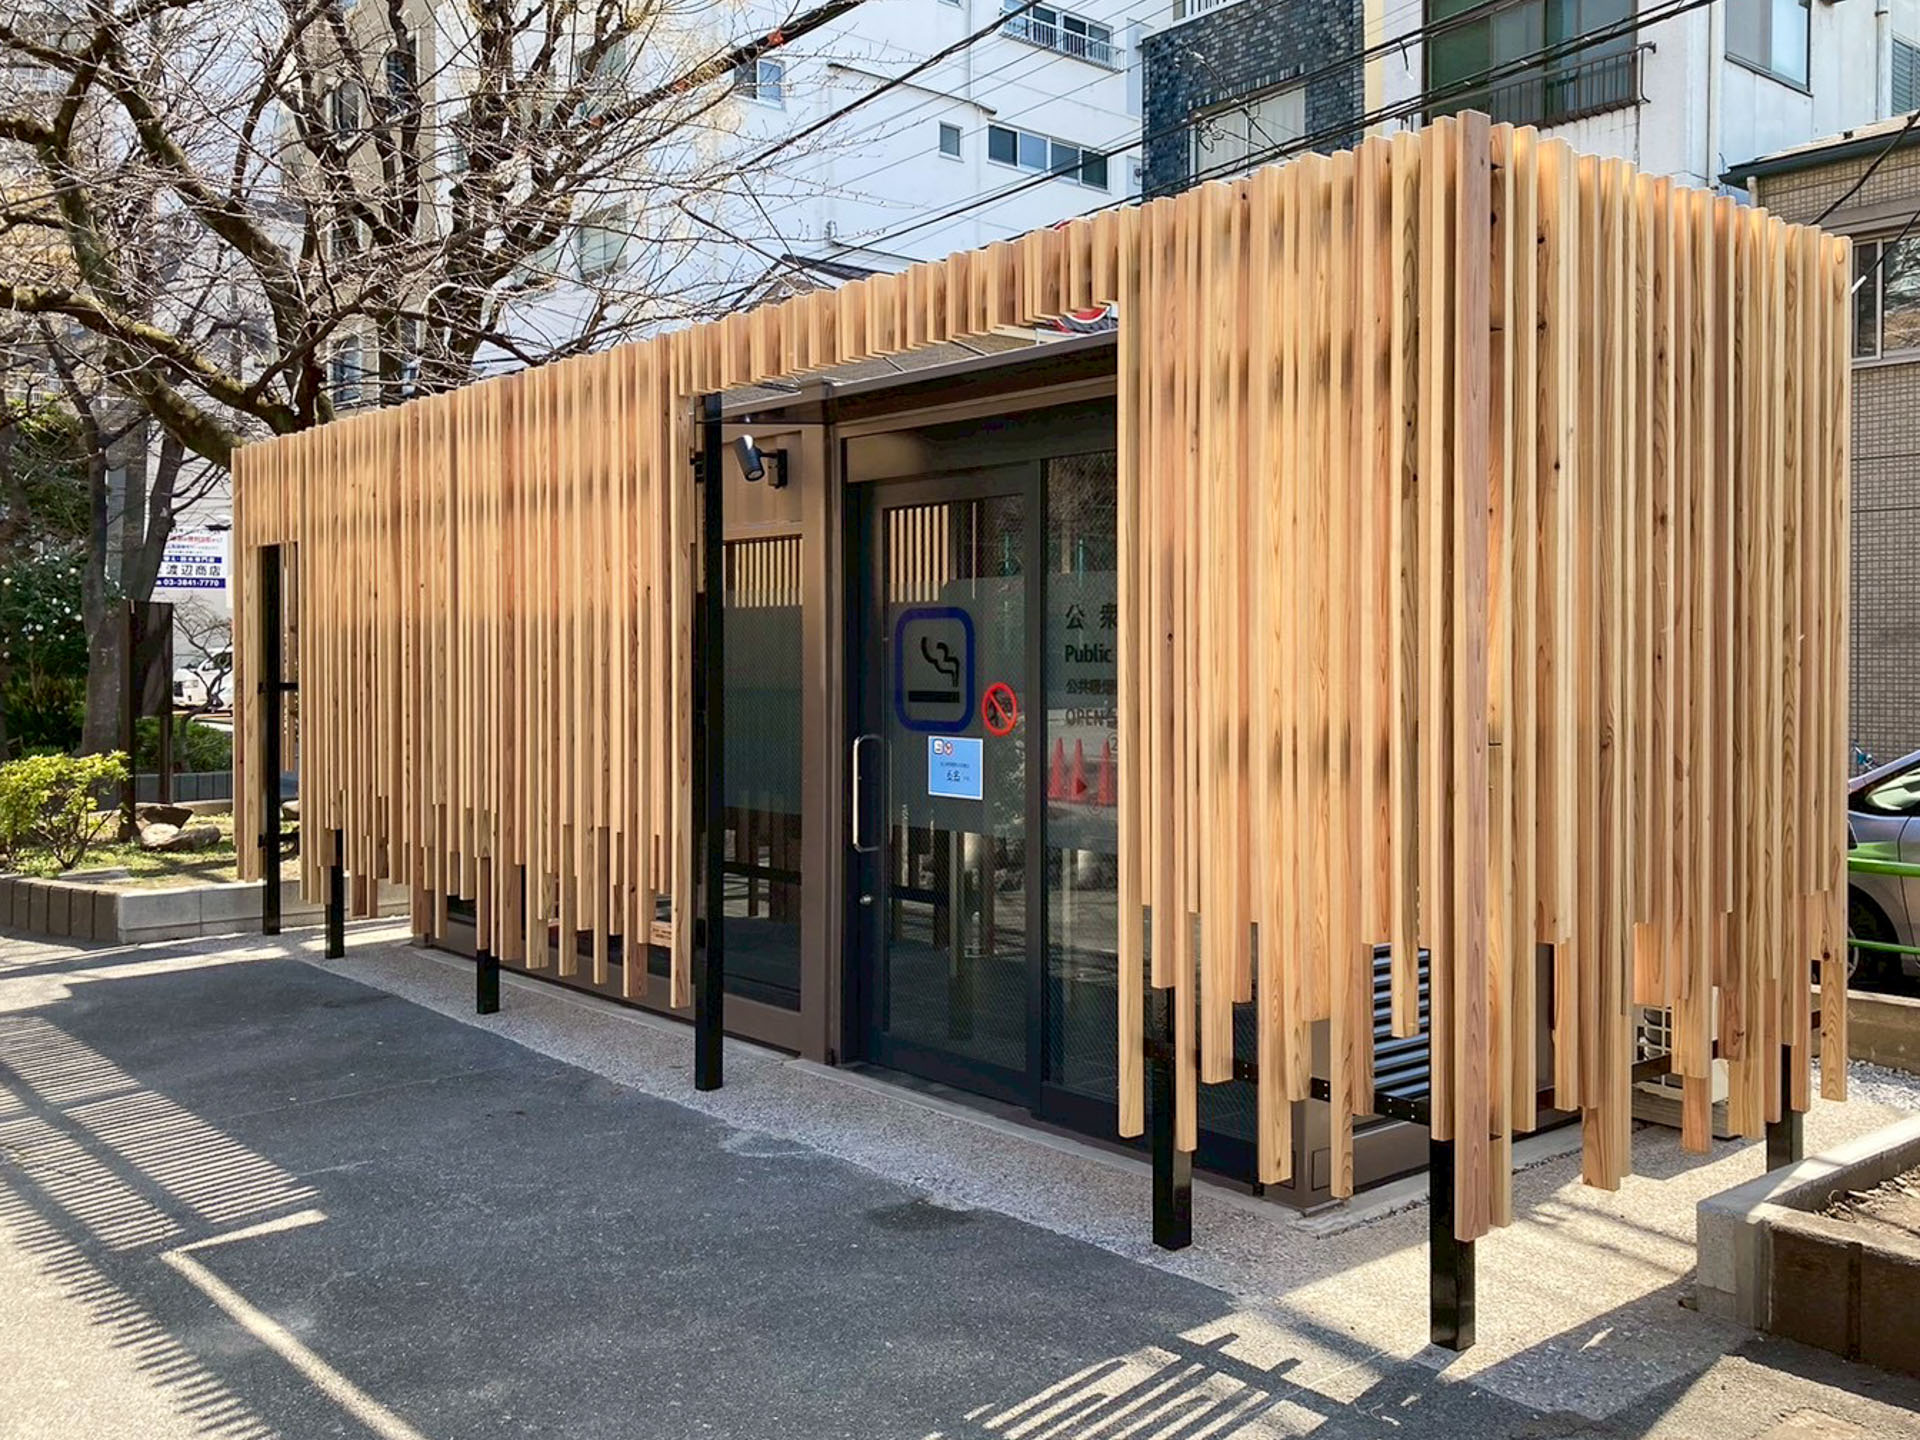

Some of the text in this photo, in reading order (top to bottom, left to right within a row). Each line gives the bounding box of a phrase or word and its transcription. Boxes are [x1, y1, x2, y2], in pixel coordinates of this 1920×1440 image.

[165, 564, 221, 576] 渡辺商店
[162, 578, 220, 588] 03-3841-7770
[1064, 643, 1112, 663] Public
[1065, 707, 1105, 726] OPEN
